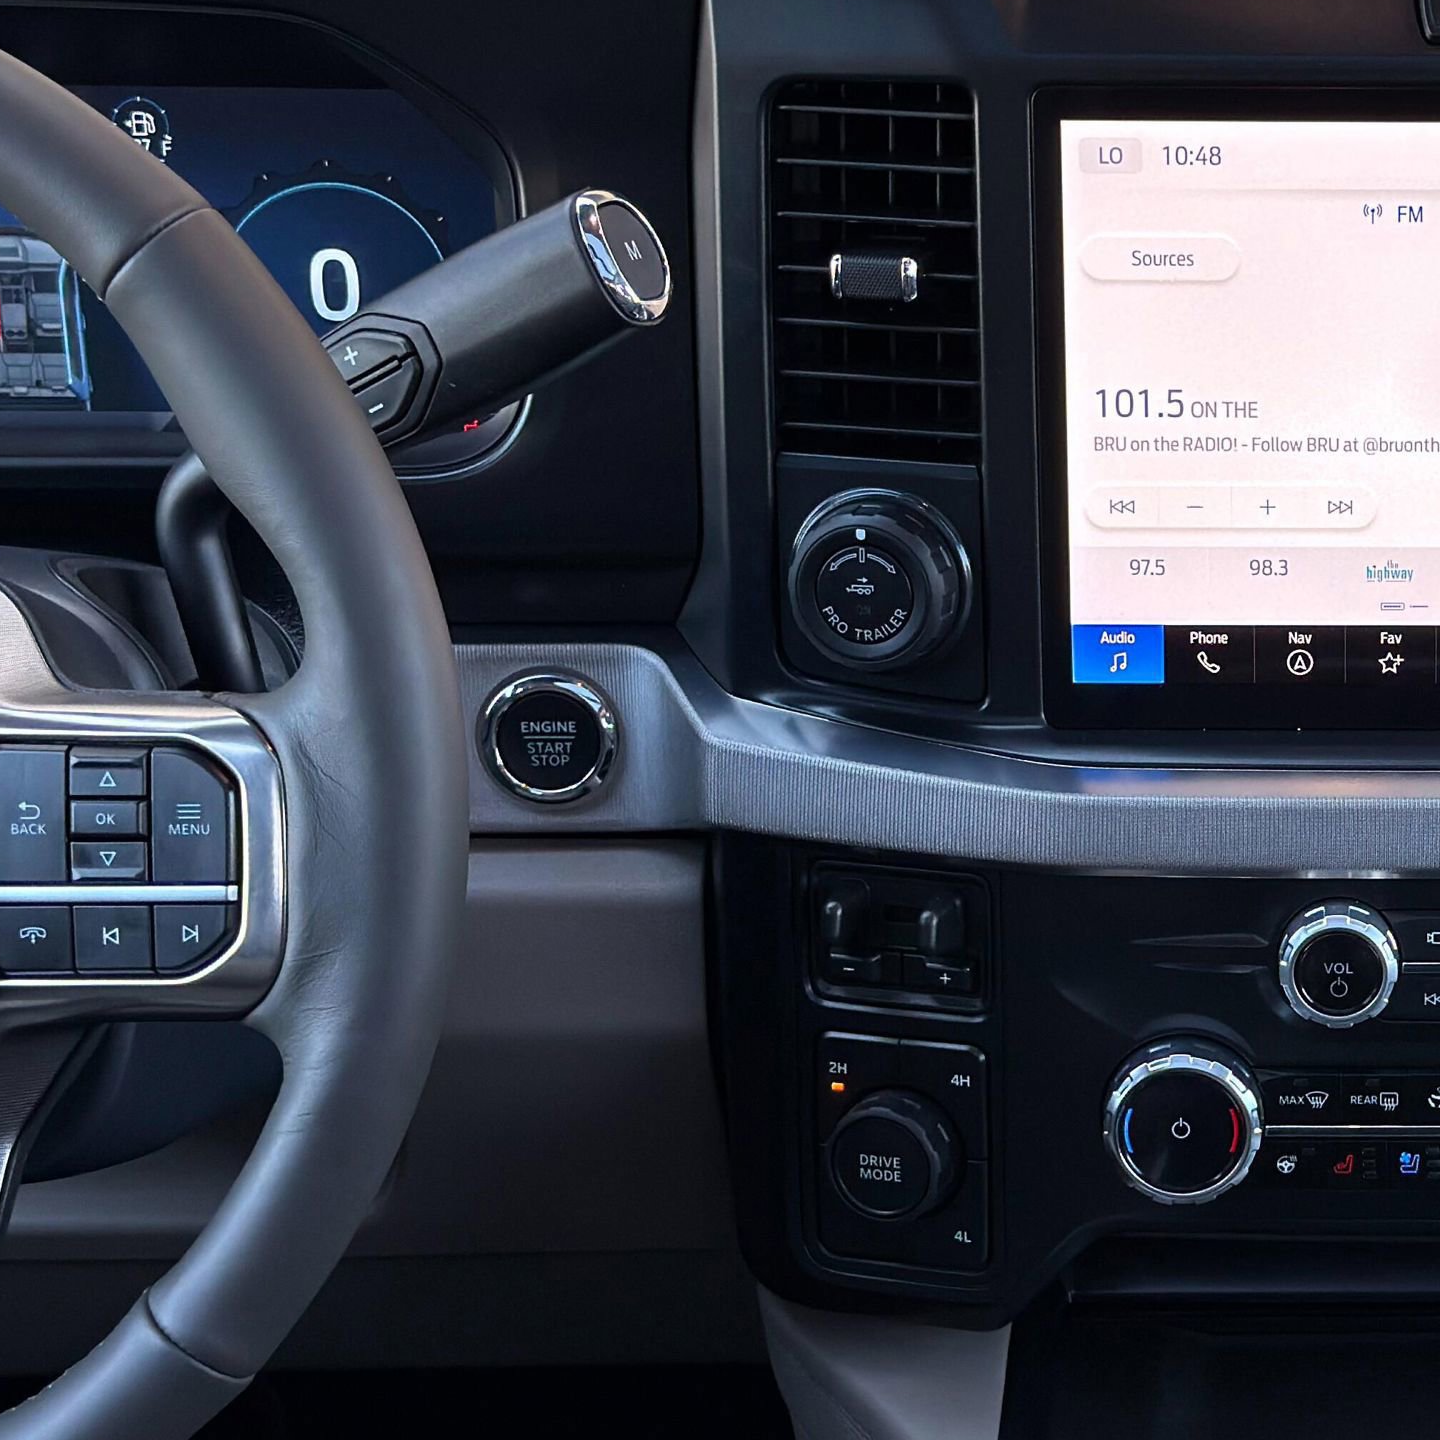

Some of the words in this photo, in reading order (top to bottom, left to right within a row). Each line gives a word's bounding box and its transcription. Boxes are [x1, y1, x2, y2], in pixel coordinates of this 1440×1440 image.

[162, 141, 172, 156] F
[1099, 147, 1122, 164] LO
[1162, 146, 1221, 166] 10:48
[1398, 206, 1423, 223] FM
[624, 240, 642, 260] M
[1131, 250, 1194, 267] Sources
[311, 248, 360, 321] 0
[1095, 389, 1184, 419] 101.5
[1191, 401, 1217, 419] ON
[1222, 401, 1258, 418] THE
[1094, 436, 1126, 452] BRU
[1131, 440, 1150, 452] on
[1154, 437, 1179, 452] the
[1184, 436, 1237, 452] RADIO!
[1252, 437, 1303, 453] Follow
[1307, 437, 1339, 453] BRU
[1343, 440, 1359, 453] at
[1130, 560, 1165, 576] 97.5
[1249, 560, 1288, 576] 98.3
[1366, 565, 1413, 582] highway
[822, 605, 848, 634] PRO
[854, 607, 908, 642] TRAILER
[1100, 632, 1135, 644] Audio
[1190, 632, 1228, 644] Phone
[1288, 632, 1312, 644] Nav
[1380, 632, 1402, 644] Fav
[520, 721, 576, 733] ENGINE
[527, 742, 573, 754] START
[531, 755, 570, 766] STOP
[96, 814, 115, 824] OK
[11, 823, 47, 835] BACK
[168, 824, 210, 836] MENU
[1323, 962, 1354, 975] VOL
[829, 1062, 848, 1075] 2H
[950, 1074, 971, 1088] 4H
[1279, 1095, 1305, 1105] MAX
[1350, 1094, 1377, 1105] REAR
[860, 1155, 901, 1170] DRIVE
[860, 1168, 902, 1183] MODE
[954, 1230, 971, 1244] 4L
